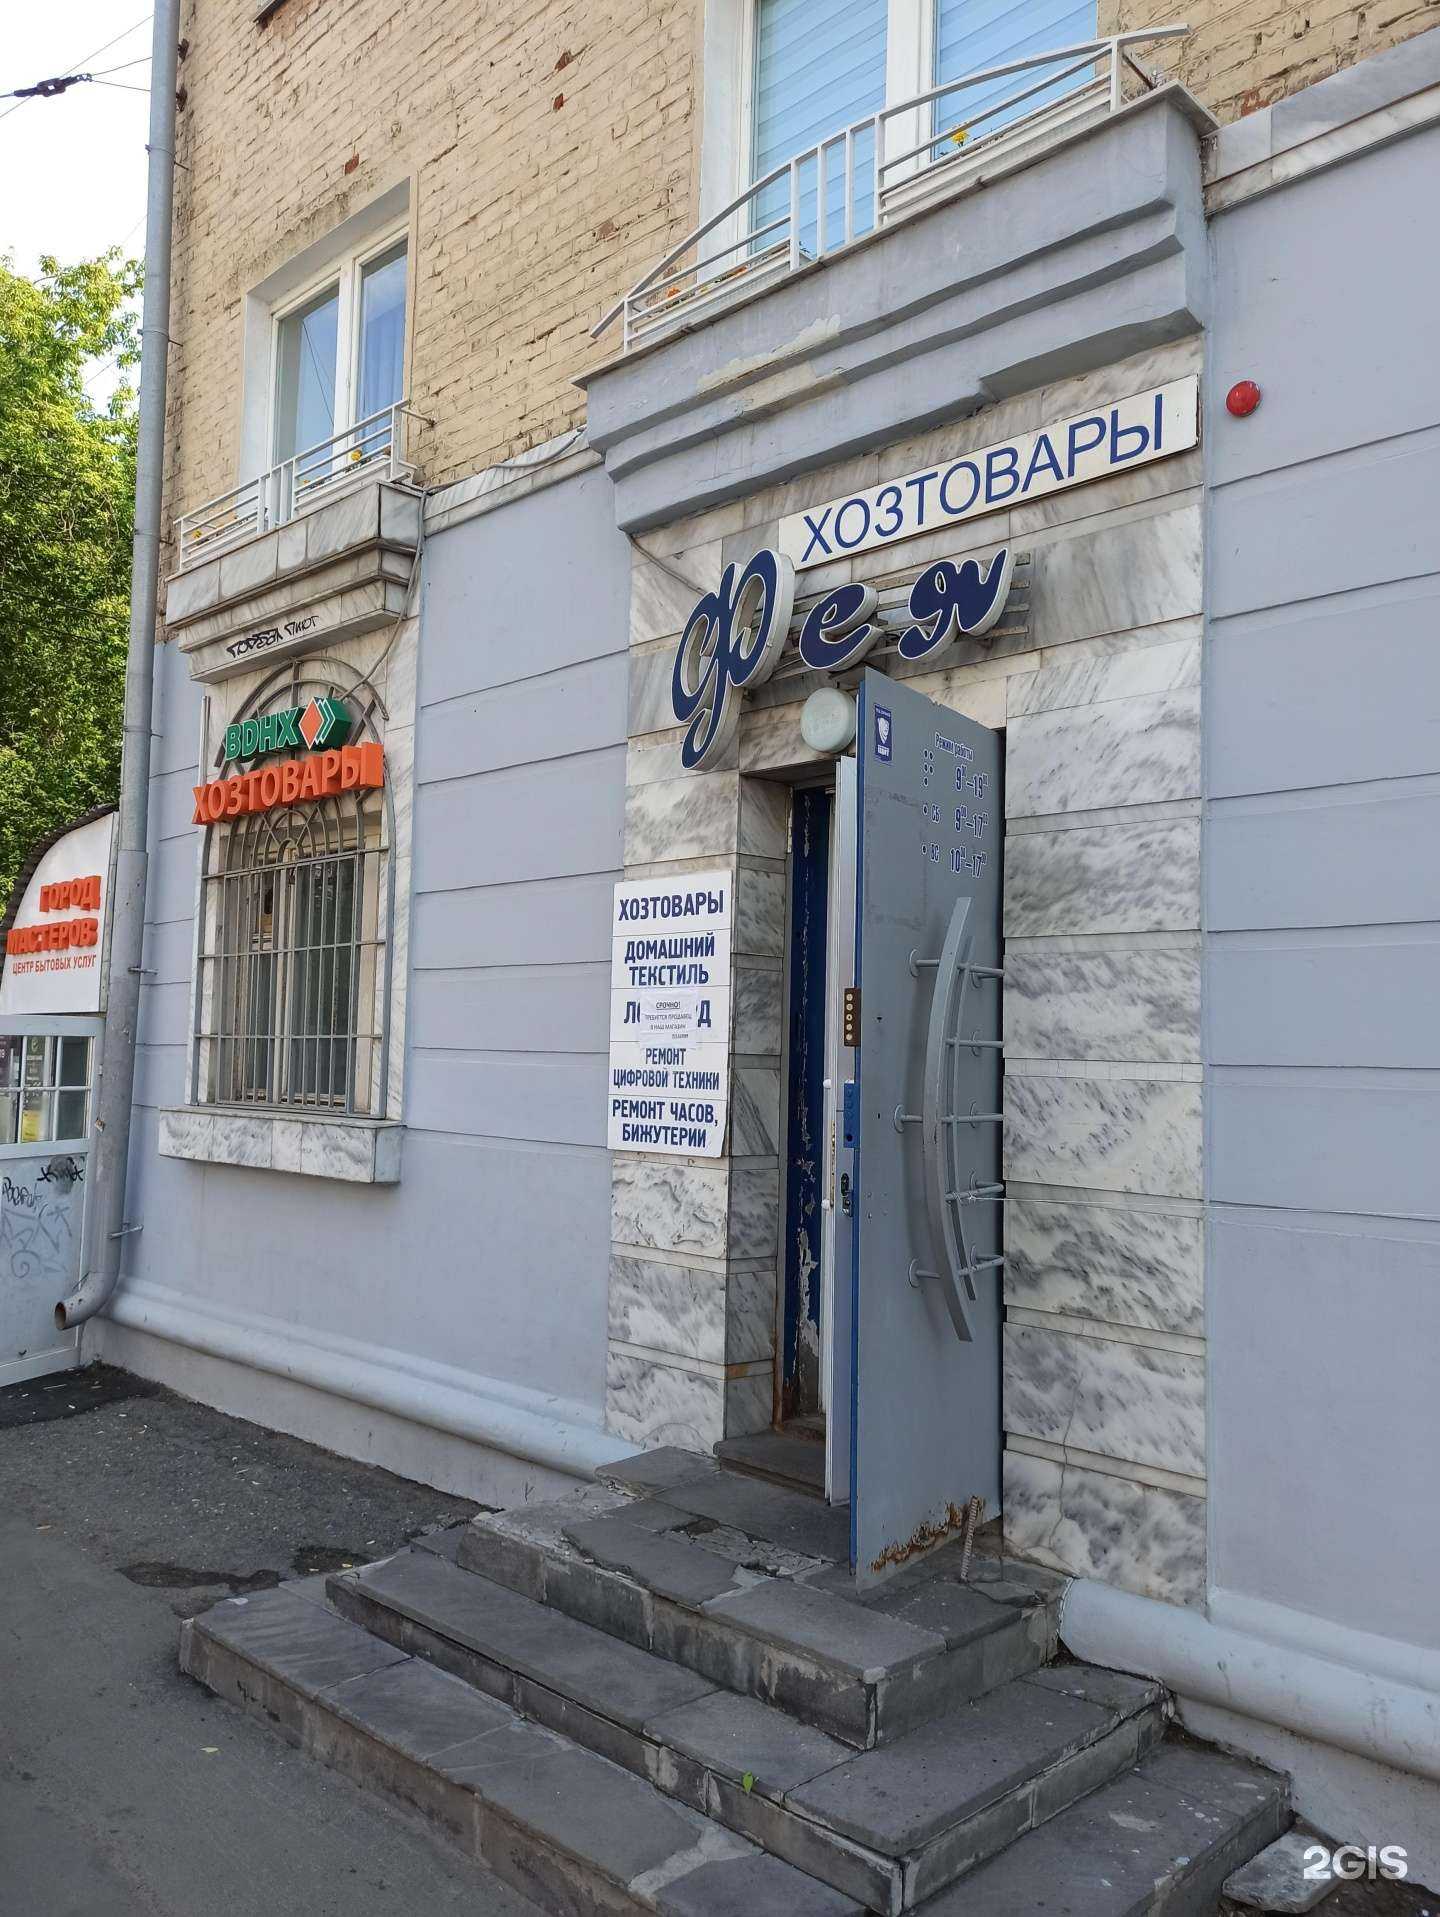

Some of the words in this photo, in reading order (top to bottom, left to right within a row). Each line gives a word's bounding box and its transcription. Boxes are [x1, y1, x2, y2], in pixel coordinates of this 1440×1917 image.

[802, 394, 1163, 563] ХОЗТОВАРЫ
[672, 547, 1014, 770] Фея
[192, 742, 384, 824] ХОЗТОВАРЫ
[40, 875, 101, 912] ГОРОД
[618, 890, 724, 921] ХОЗТОВАРЫ
[7, 917, 98, 955] МАСТЕРОВ
[624, 931, 715, 964] ДОМАШНИЙ
[13, 961, 34, 976] ЦЕНТР
[35, 957, 71, 973] БЫТОВЫХ
[73, 955, 97, 968] УСЛУГ
[629, 963, 709, 986] ТЕКСТИЛЬ
[645, 1048, 687, 1065] РЕМОНТ
[613, 1067, 668, 1088] ЦИФРОВОЙ
[673, 1071, 719, 1090] ТЕХНИКИ
[612, 1099, 665, 1120] РЕМОНТ
[670, 1102, 718, 1127] ЧАСОВ,
[622, 1123, 707, 1148] БИЖУТЕРИИ
